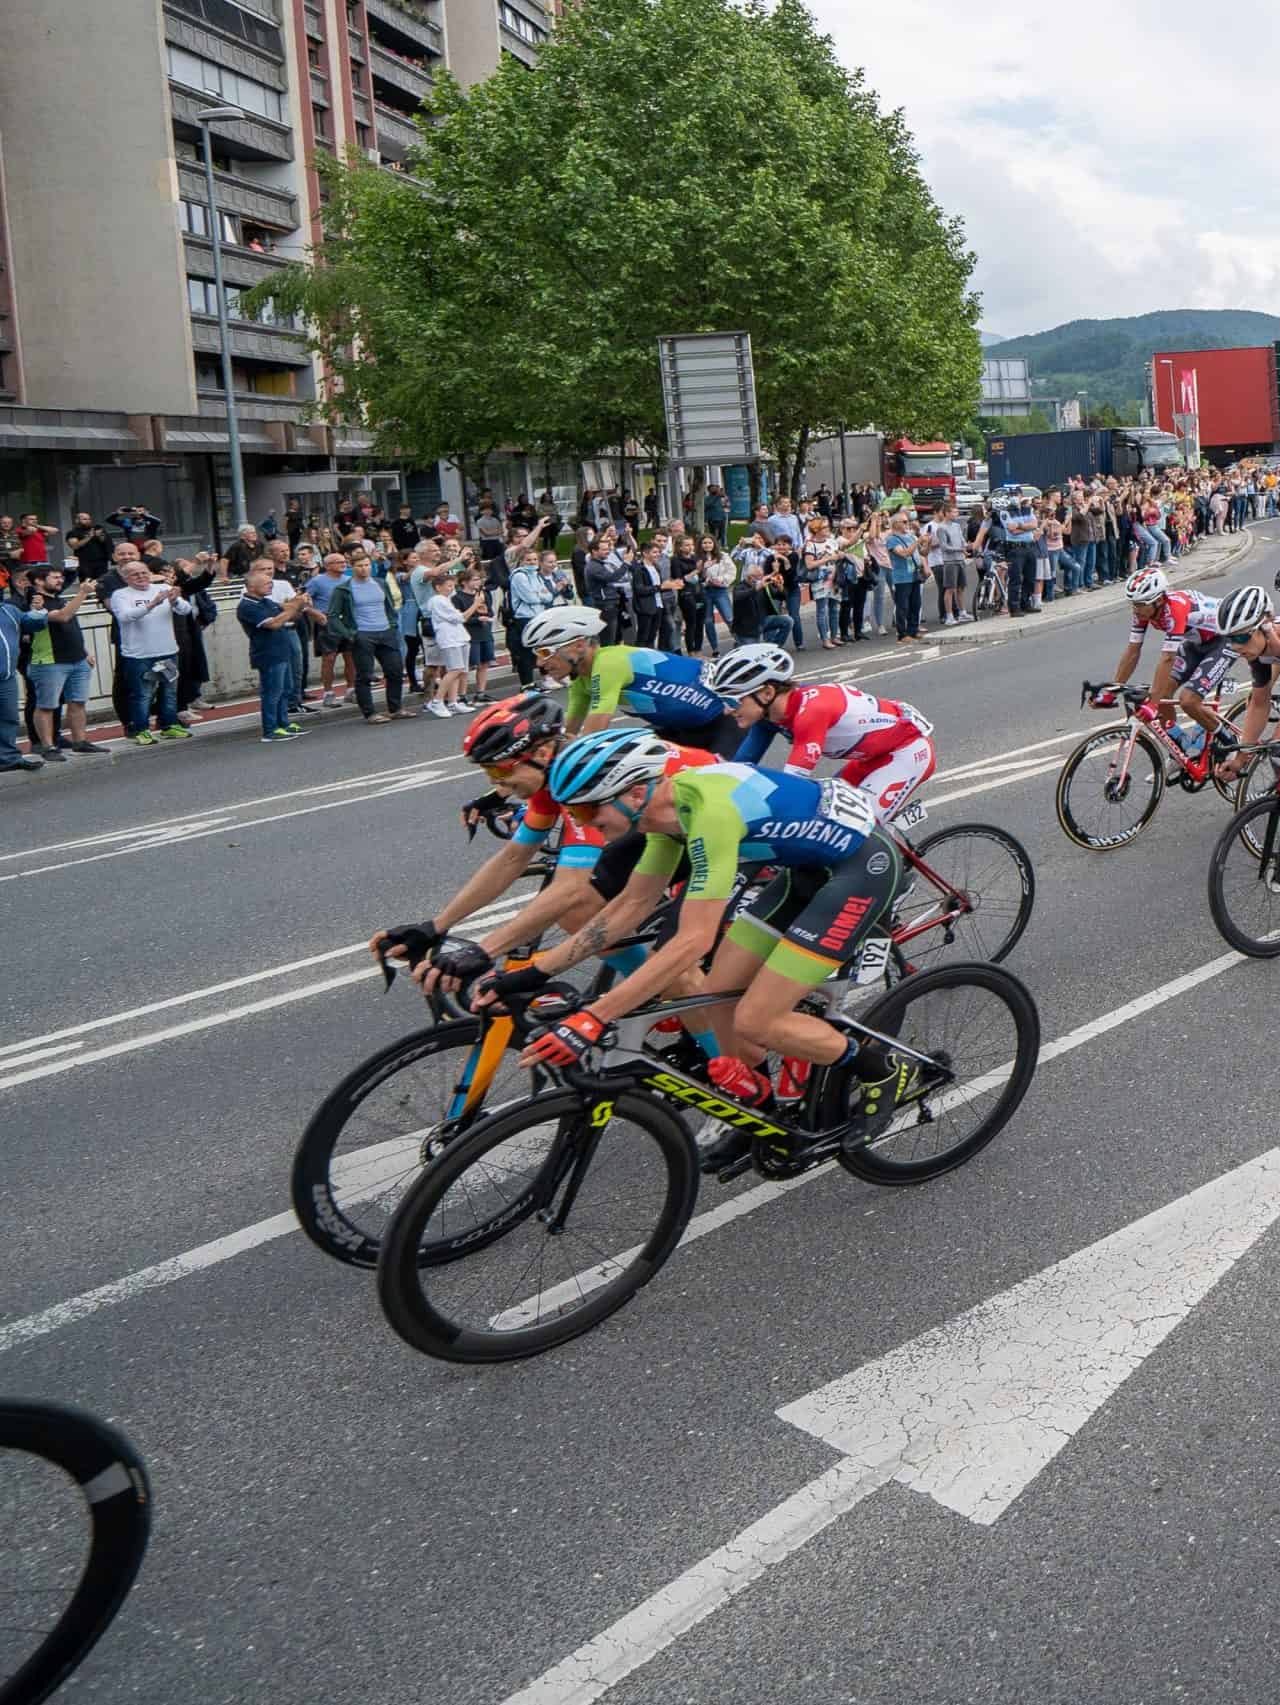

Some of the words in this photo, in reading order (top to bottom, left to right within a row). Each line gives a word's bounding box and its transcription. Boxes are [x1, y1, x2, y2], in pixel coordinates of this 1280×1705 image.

[641, 679, 713, 710] SLOVENIA
[902, 804, 926, 827] 132
[753, 820, 854, 852] SLOVENIA
[818, 896, 874, 952] DOMEL
[861, 942, 889, 969] 192
[642, 1073, 788, 1137] SCOTT
